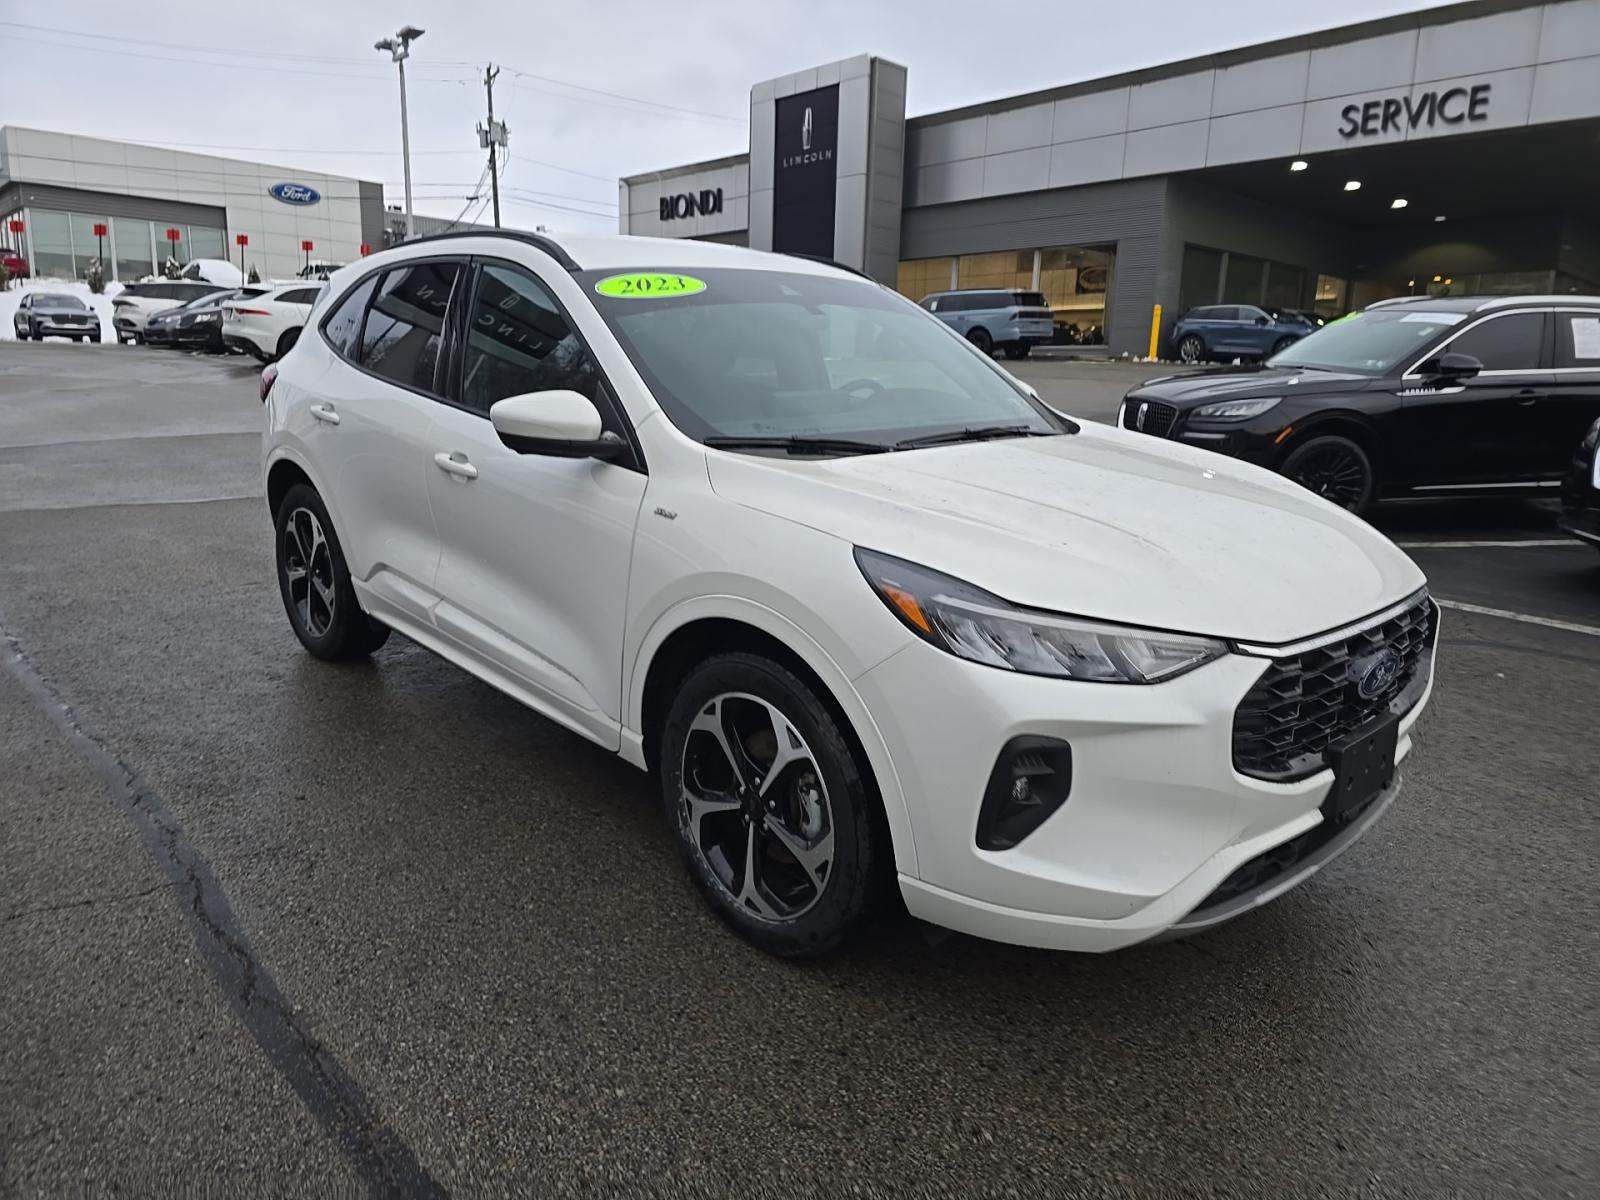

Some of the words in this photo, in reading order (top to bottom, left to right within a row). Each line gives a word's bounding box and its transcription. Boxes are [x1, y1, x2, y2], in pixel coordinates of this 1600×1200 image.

[1338, 84, 1491, 138] SERVICE
[783, 149, 832, 168] LINCOLN
[281, 185, 311, 201] Ford
[659, 187, 723, 221] BIONDI
[618, 277, 686, 294] 2023
